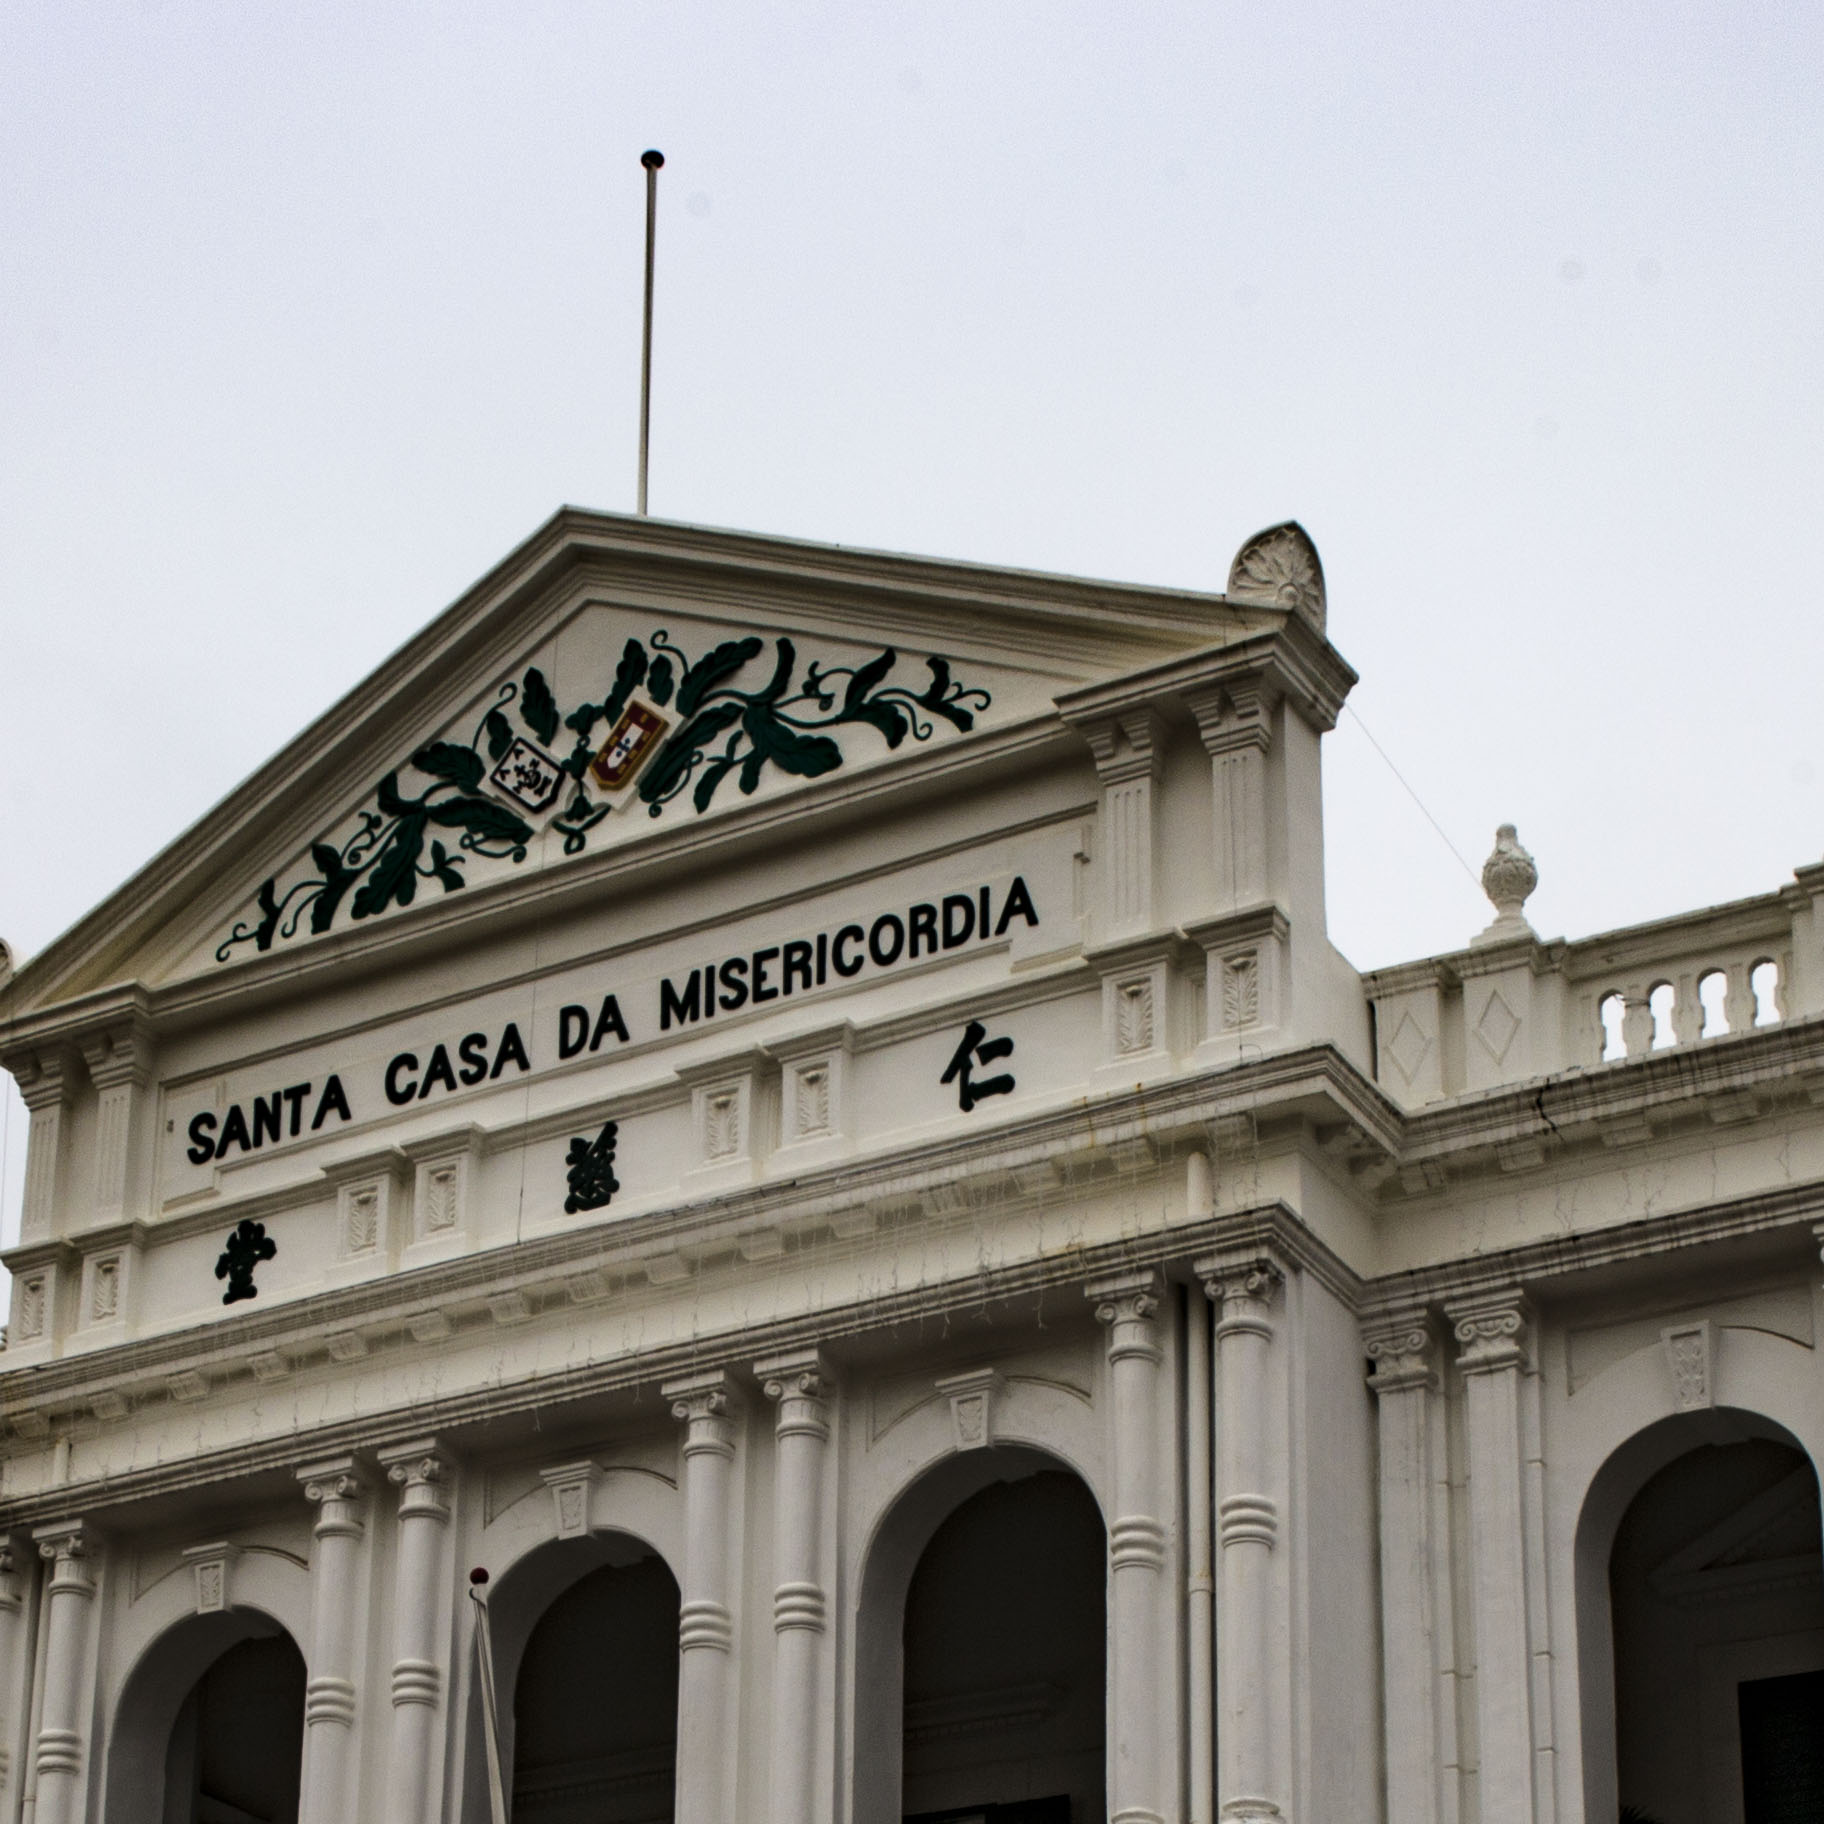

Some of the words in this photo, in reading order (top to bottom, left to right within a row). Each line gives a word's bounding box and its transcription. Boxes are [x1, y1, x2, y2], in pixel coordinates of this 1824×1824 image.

[187, 1074, 353, 1166] SANTA
[383, 1023, 530, 1107] CASA
[558, 994, 631, 1061] DA
[659, 876, 1040, 1032] MISERICORDIA
